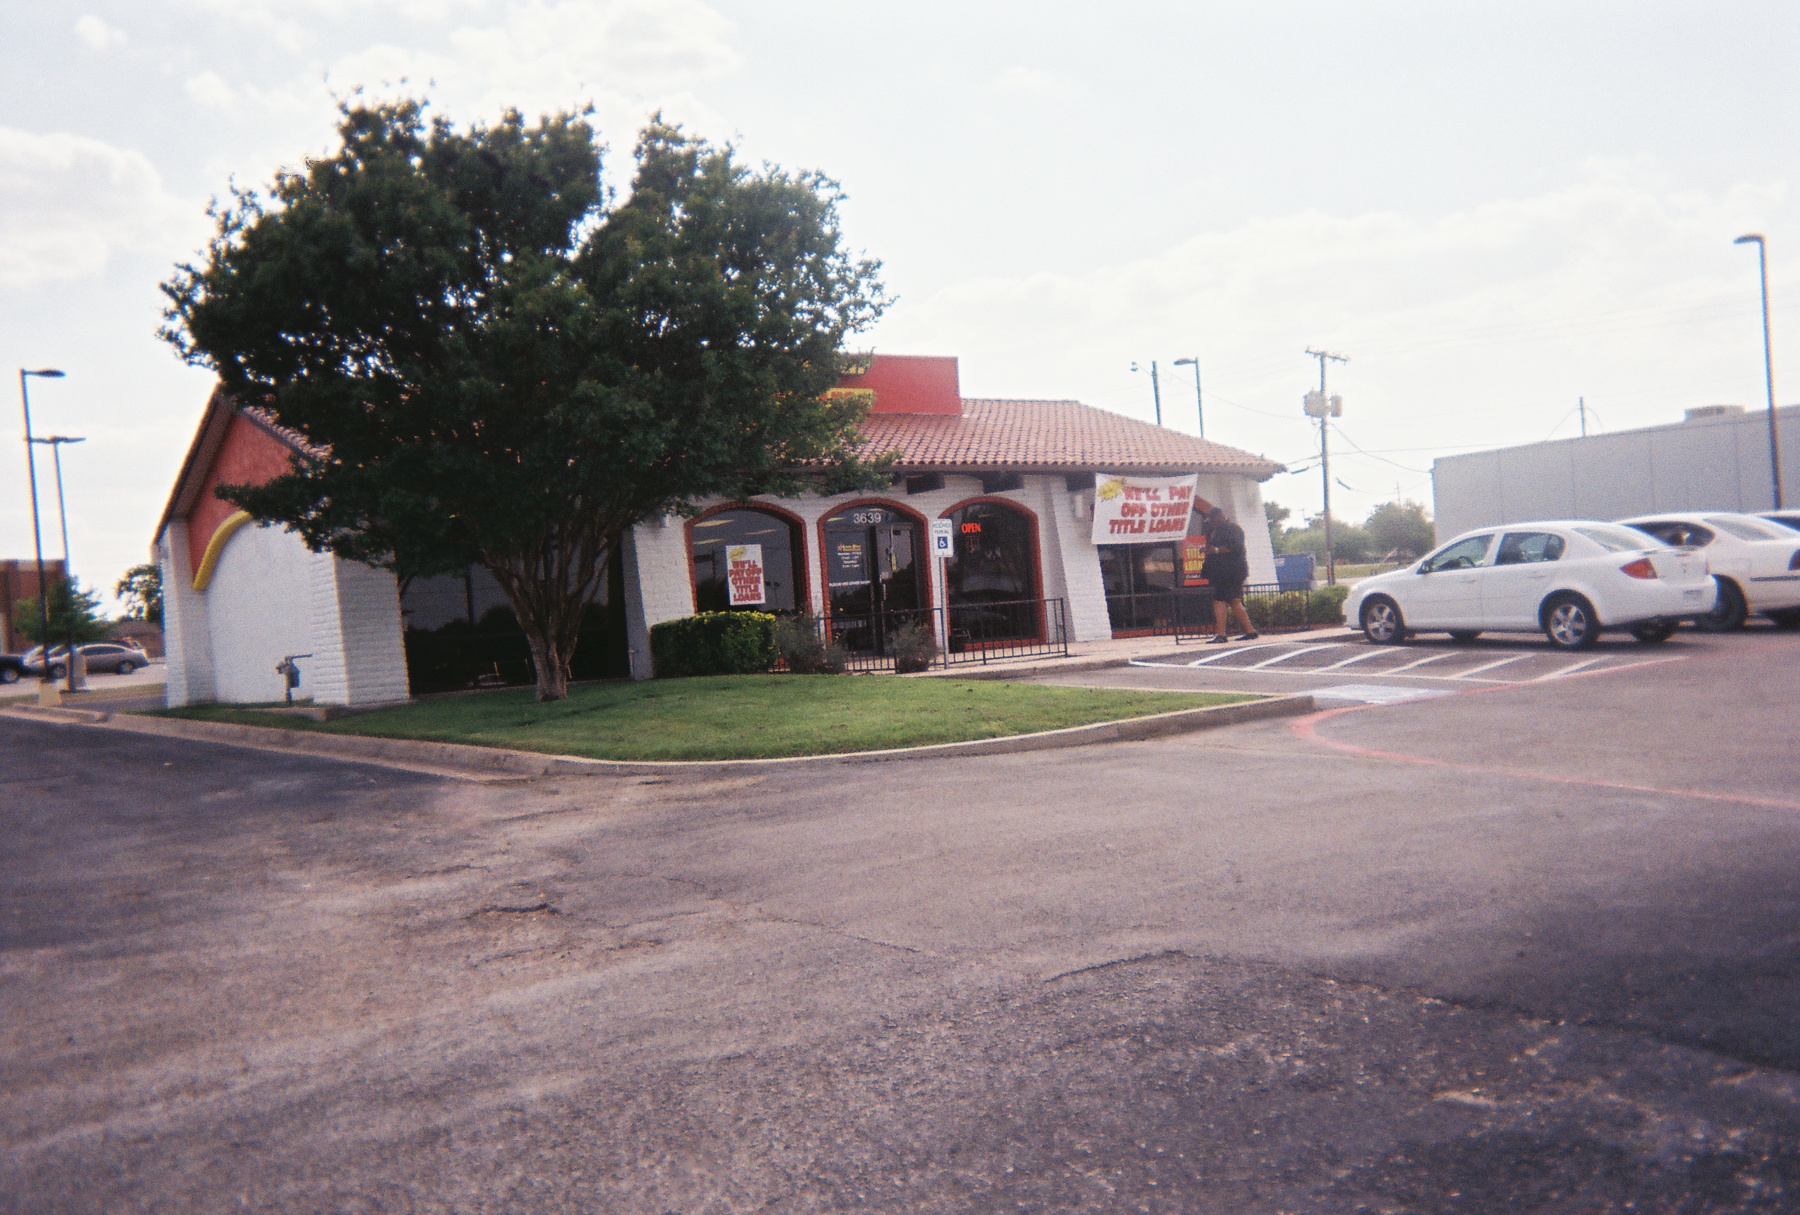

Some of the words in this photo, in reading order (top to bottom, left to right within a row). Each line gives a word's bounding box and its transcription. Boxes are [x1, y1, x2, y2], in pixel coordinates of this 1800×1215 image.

[1120, 502, 1147, 517] OFF
[1150, 501, 1190, 517] OTHER
[853, 512, 882, 524] 3639
[961, 522, 981, 534] OPEN
[1108, 519, 1147, 534] TITLE
[1148, 517, 1188, 533] LOANS
[734, 584, 760, 594] TITLE
[733, 592, 762, 602] LOANS
